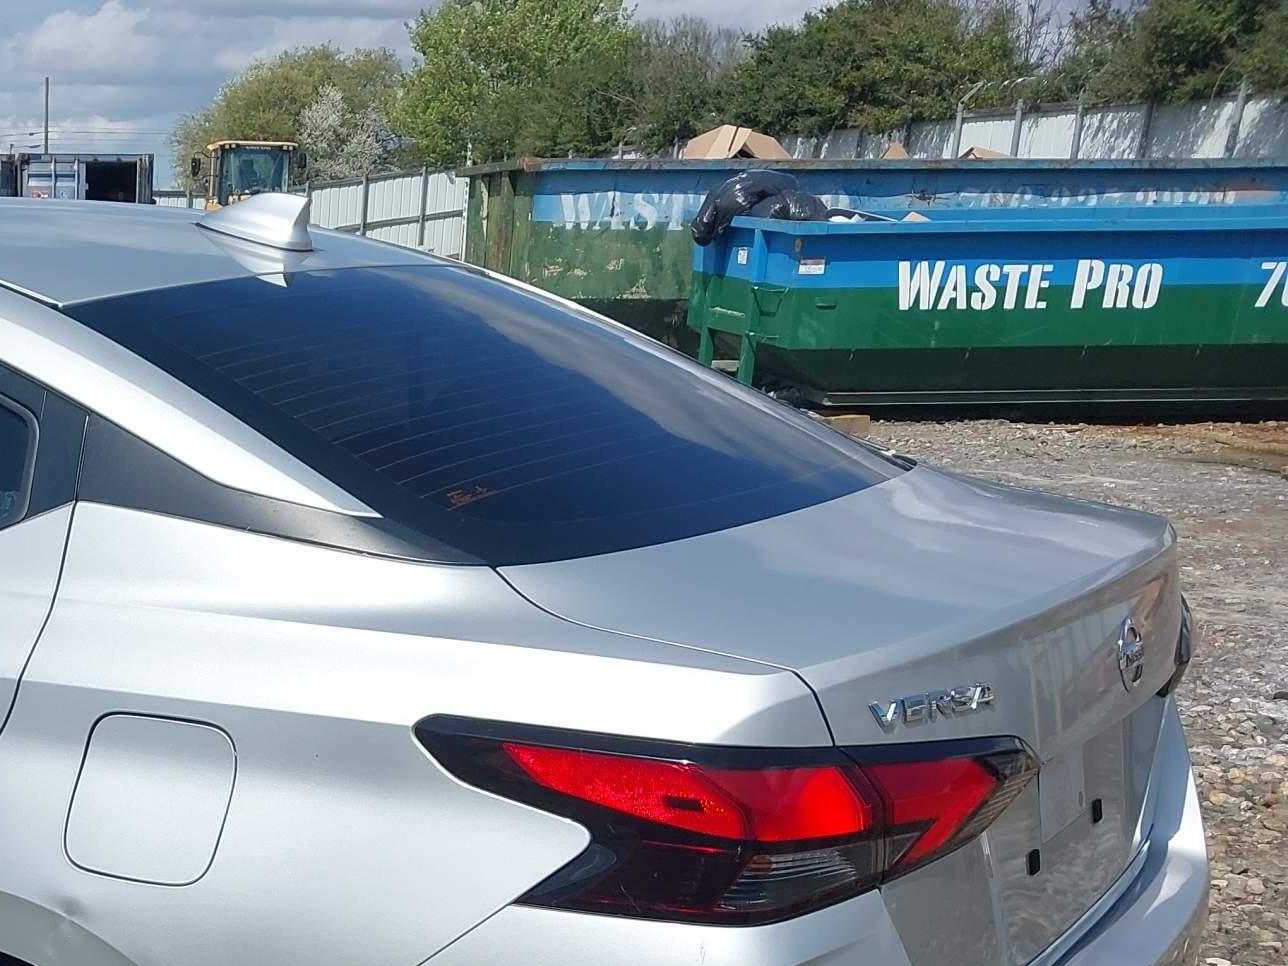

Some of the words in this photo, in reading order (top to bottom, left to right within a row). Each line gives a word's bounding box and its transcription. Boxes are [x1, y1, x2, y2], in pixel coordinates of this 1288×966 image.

[898, 260, 1054, 311] WASTE
[1070, 259, 1164, 310] PRO
[868, 682, 996, 734] VERSA
